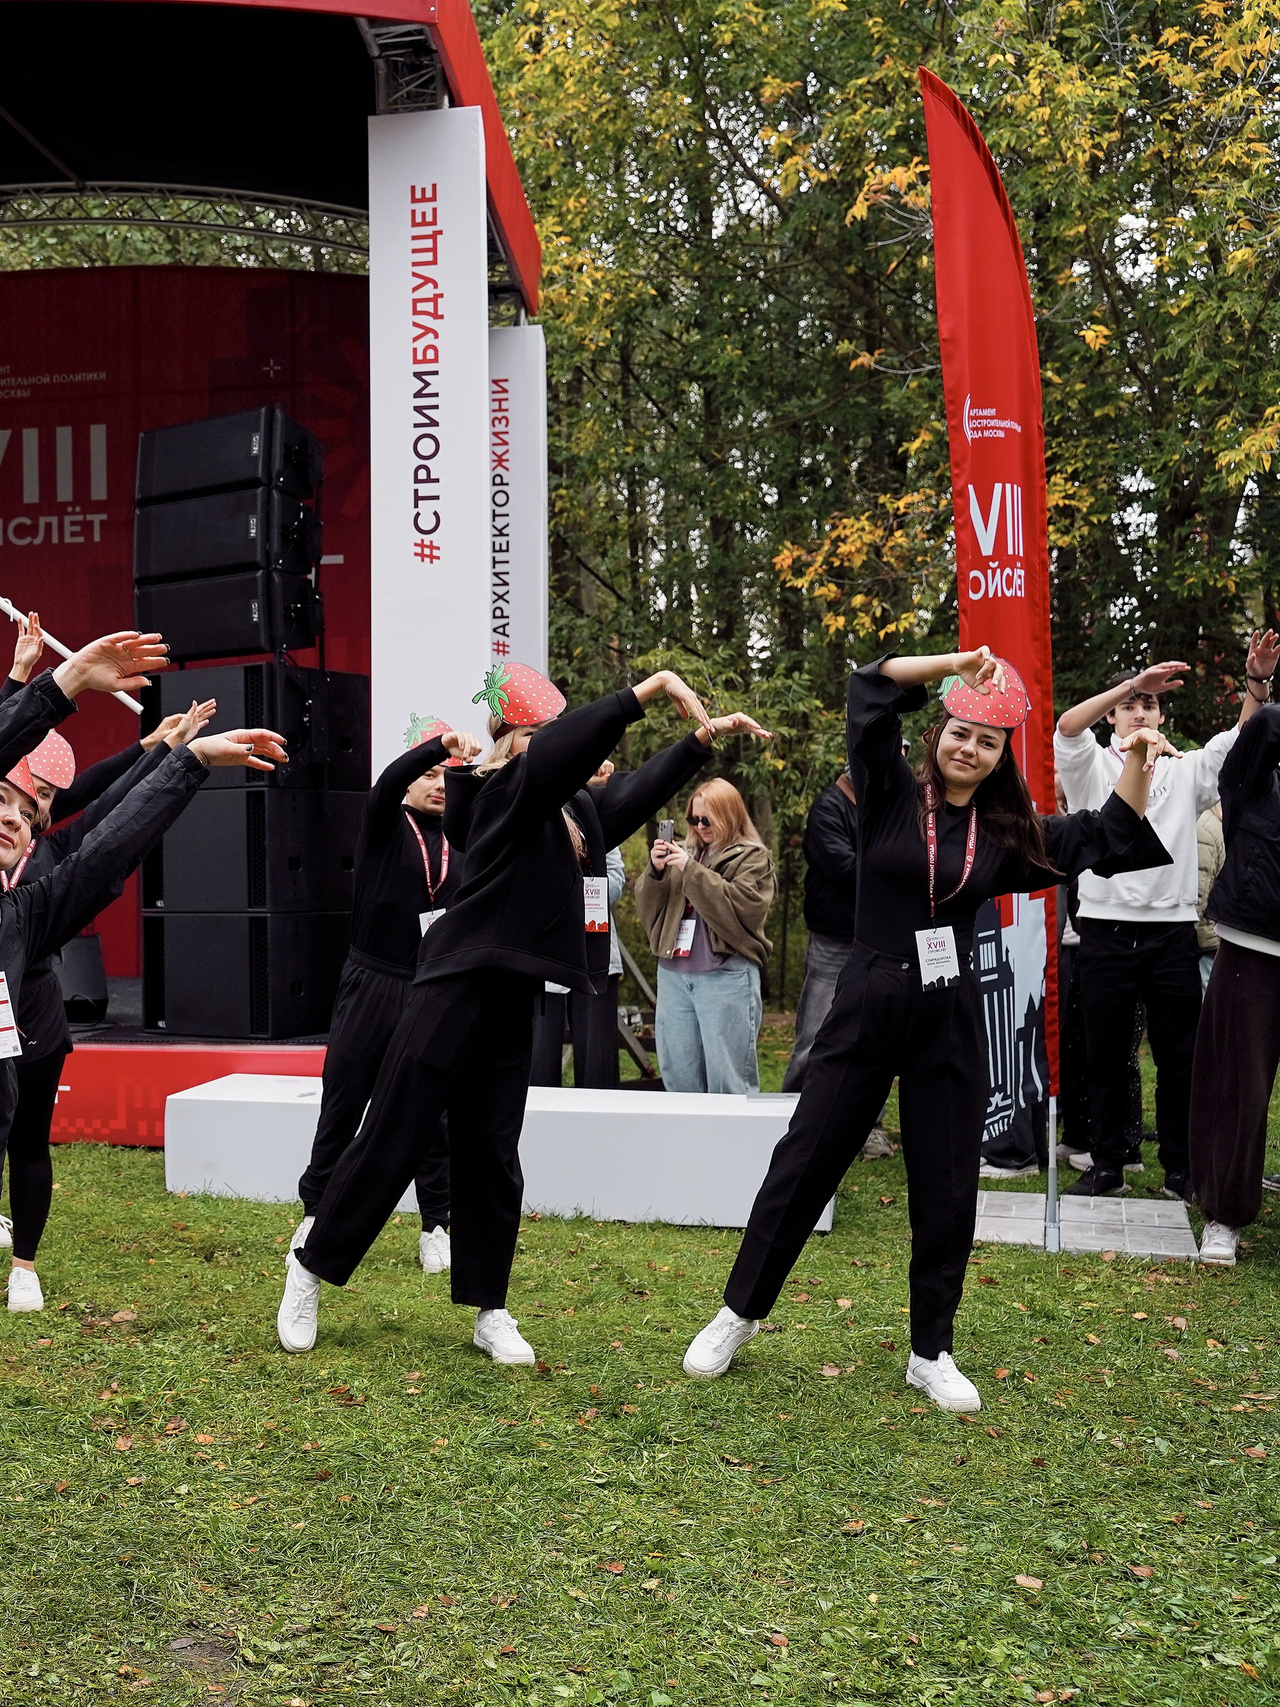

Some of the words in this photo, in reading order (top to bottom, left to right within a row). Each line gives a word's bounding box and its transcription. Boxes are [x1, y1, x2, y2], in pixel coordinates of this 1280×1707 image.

[52, 371, 107, 384] ПОЛИТИКИ
[410, 183, 444, 564] #СТРОИМБУДУЩЕЕ
[491, 377, 511, 657] #АРХИТЕКТОРЖИЗНИ
[967, 483, 1024, 557] VIII
[969, 561, 1025, 600] ОЙСЛЁТ
[927, 940, 946, 951] XVIII
